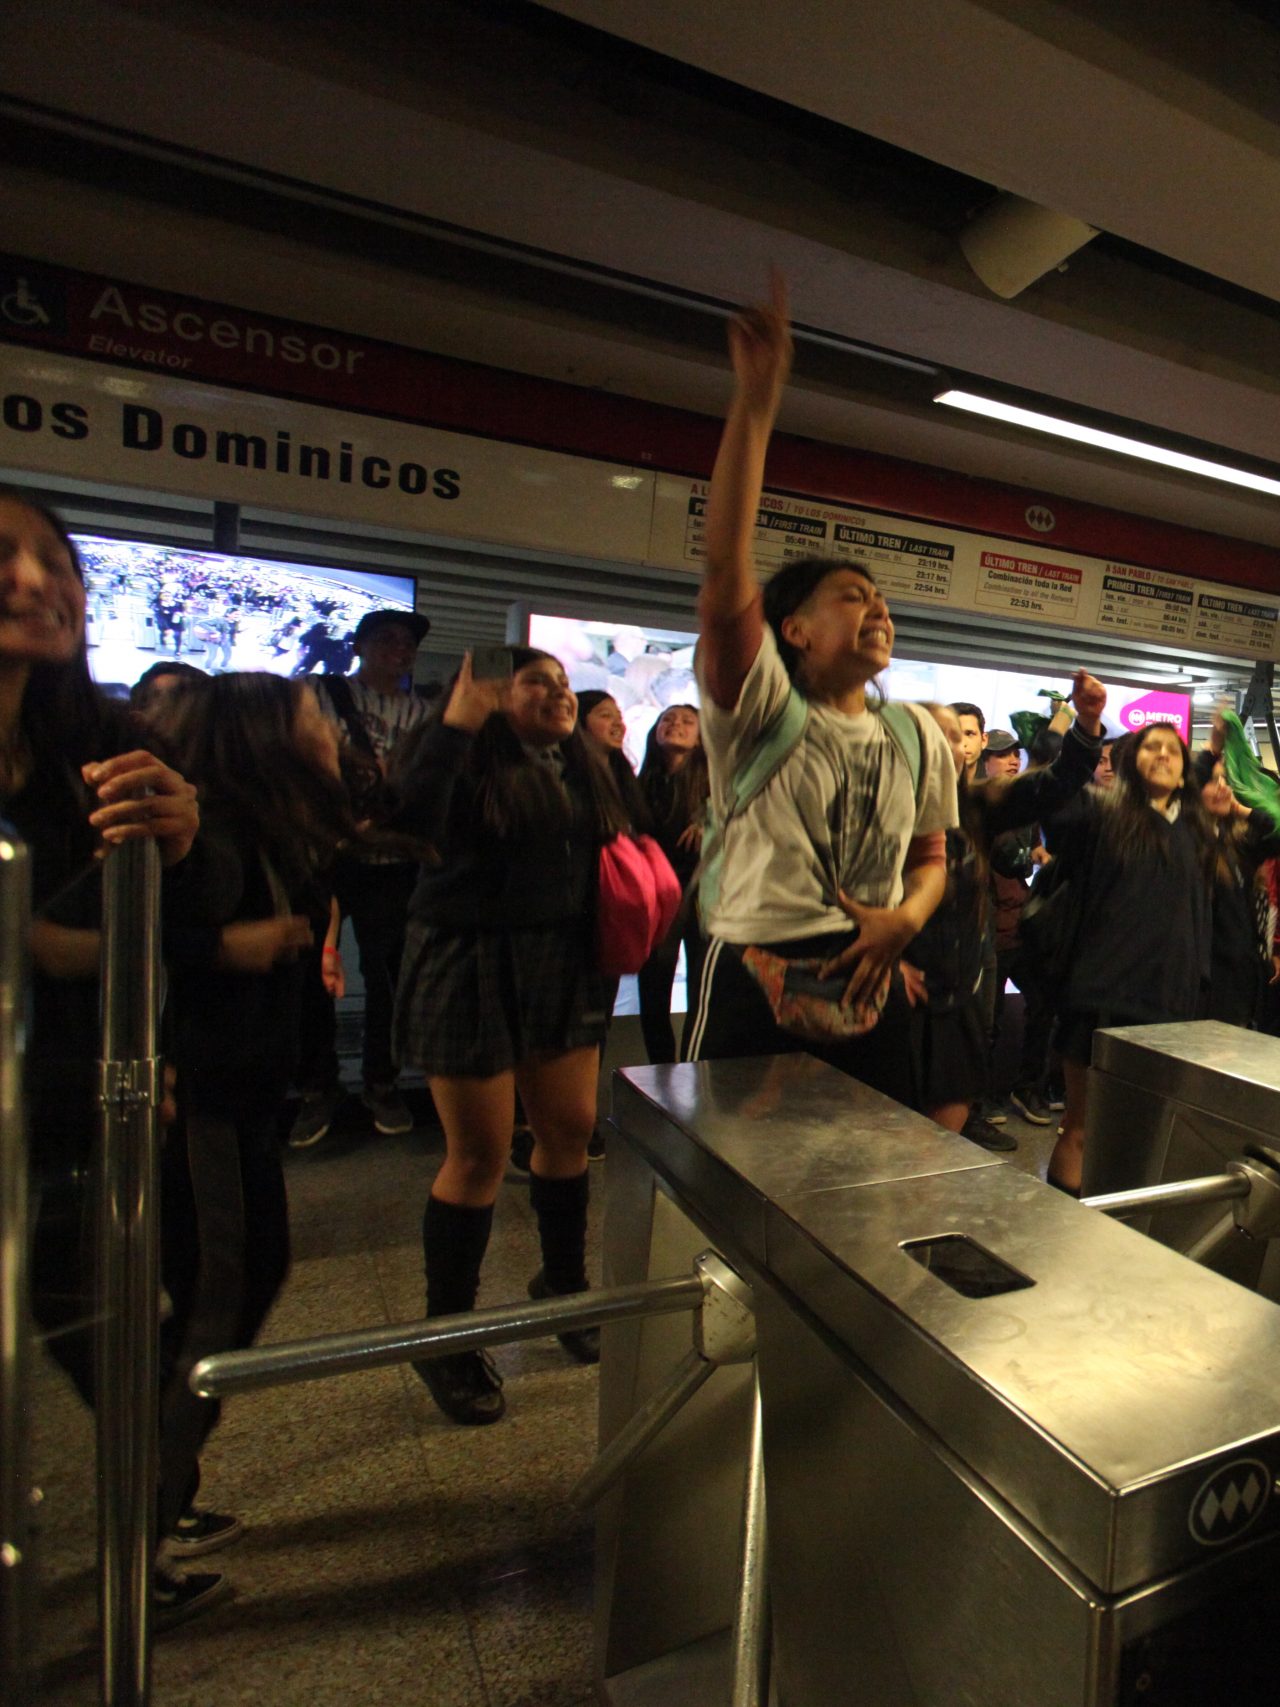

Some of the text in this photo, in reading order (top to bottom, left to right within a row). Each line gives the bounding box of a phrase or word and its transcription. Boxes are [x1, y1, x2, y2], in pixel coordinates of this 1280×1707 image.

[89, 286, 364, 375] Ascensor
[89, 335, 193, 369] Elevator
[3, 395, 461, 500] os Dominicos
[800, 522, 823, 534] TRAIN
[839, 527, 875, 545] ÚLTIMO
[878, 536, 901, 549] TREN
[909, 544, 927, 554] LAST
[929, 547, 950, 558] TRAIN
[916, 571, 934, 580] 23:17
[984, 554, 1015, 569] ÚLTIMO
[1018, 562, 1038, 575] TREN
[1045, 570, 1060, 578] LAST
[1062, 573, 1080, 582] TRAIN
[1112, 565, 1127, 576] SAN
[1128, 568, 1151, 579] PABLO
[914, 583, 933, 593] 22:54
[988, 570, 1072, 592] Combinación toda la Red
[1107, 579, 1135, 592] PRIMER
[1137, 584, 1155, 596] TREN
[1010, 598, 1029, 608] 22:53
[1145, 711, 1183, 723] METRO
